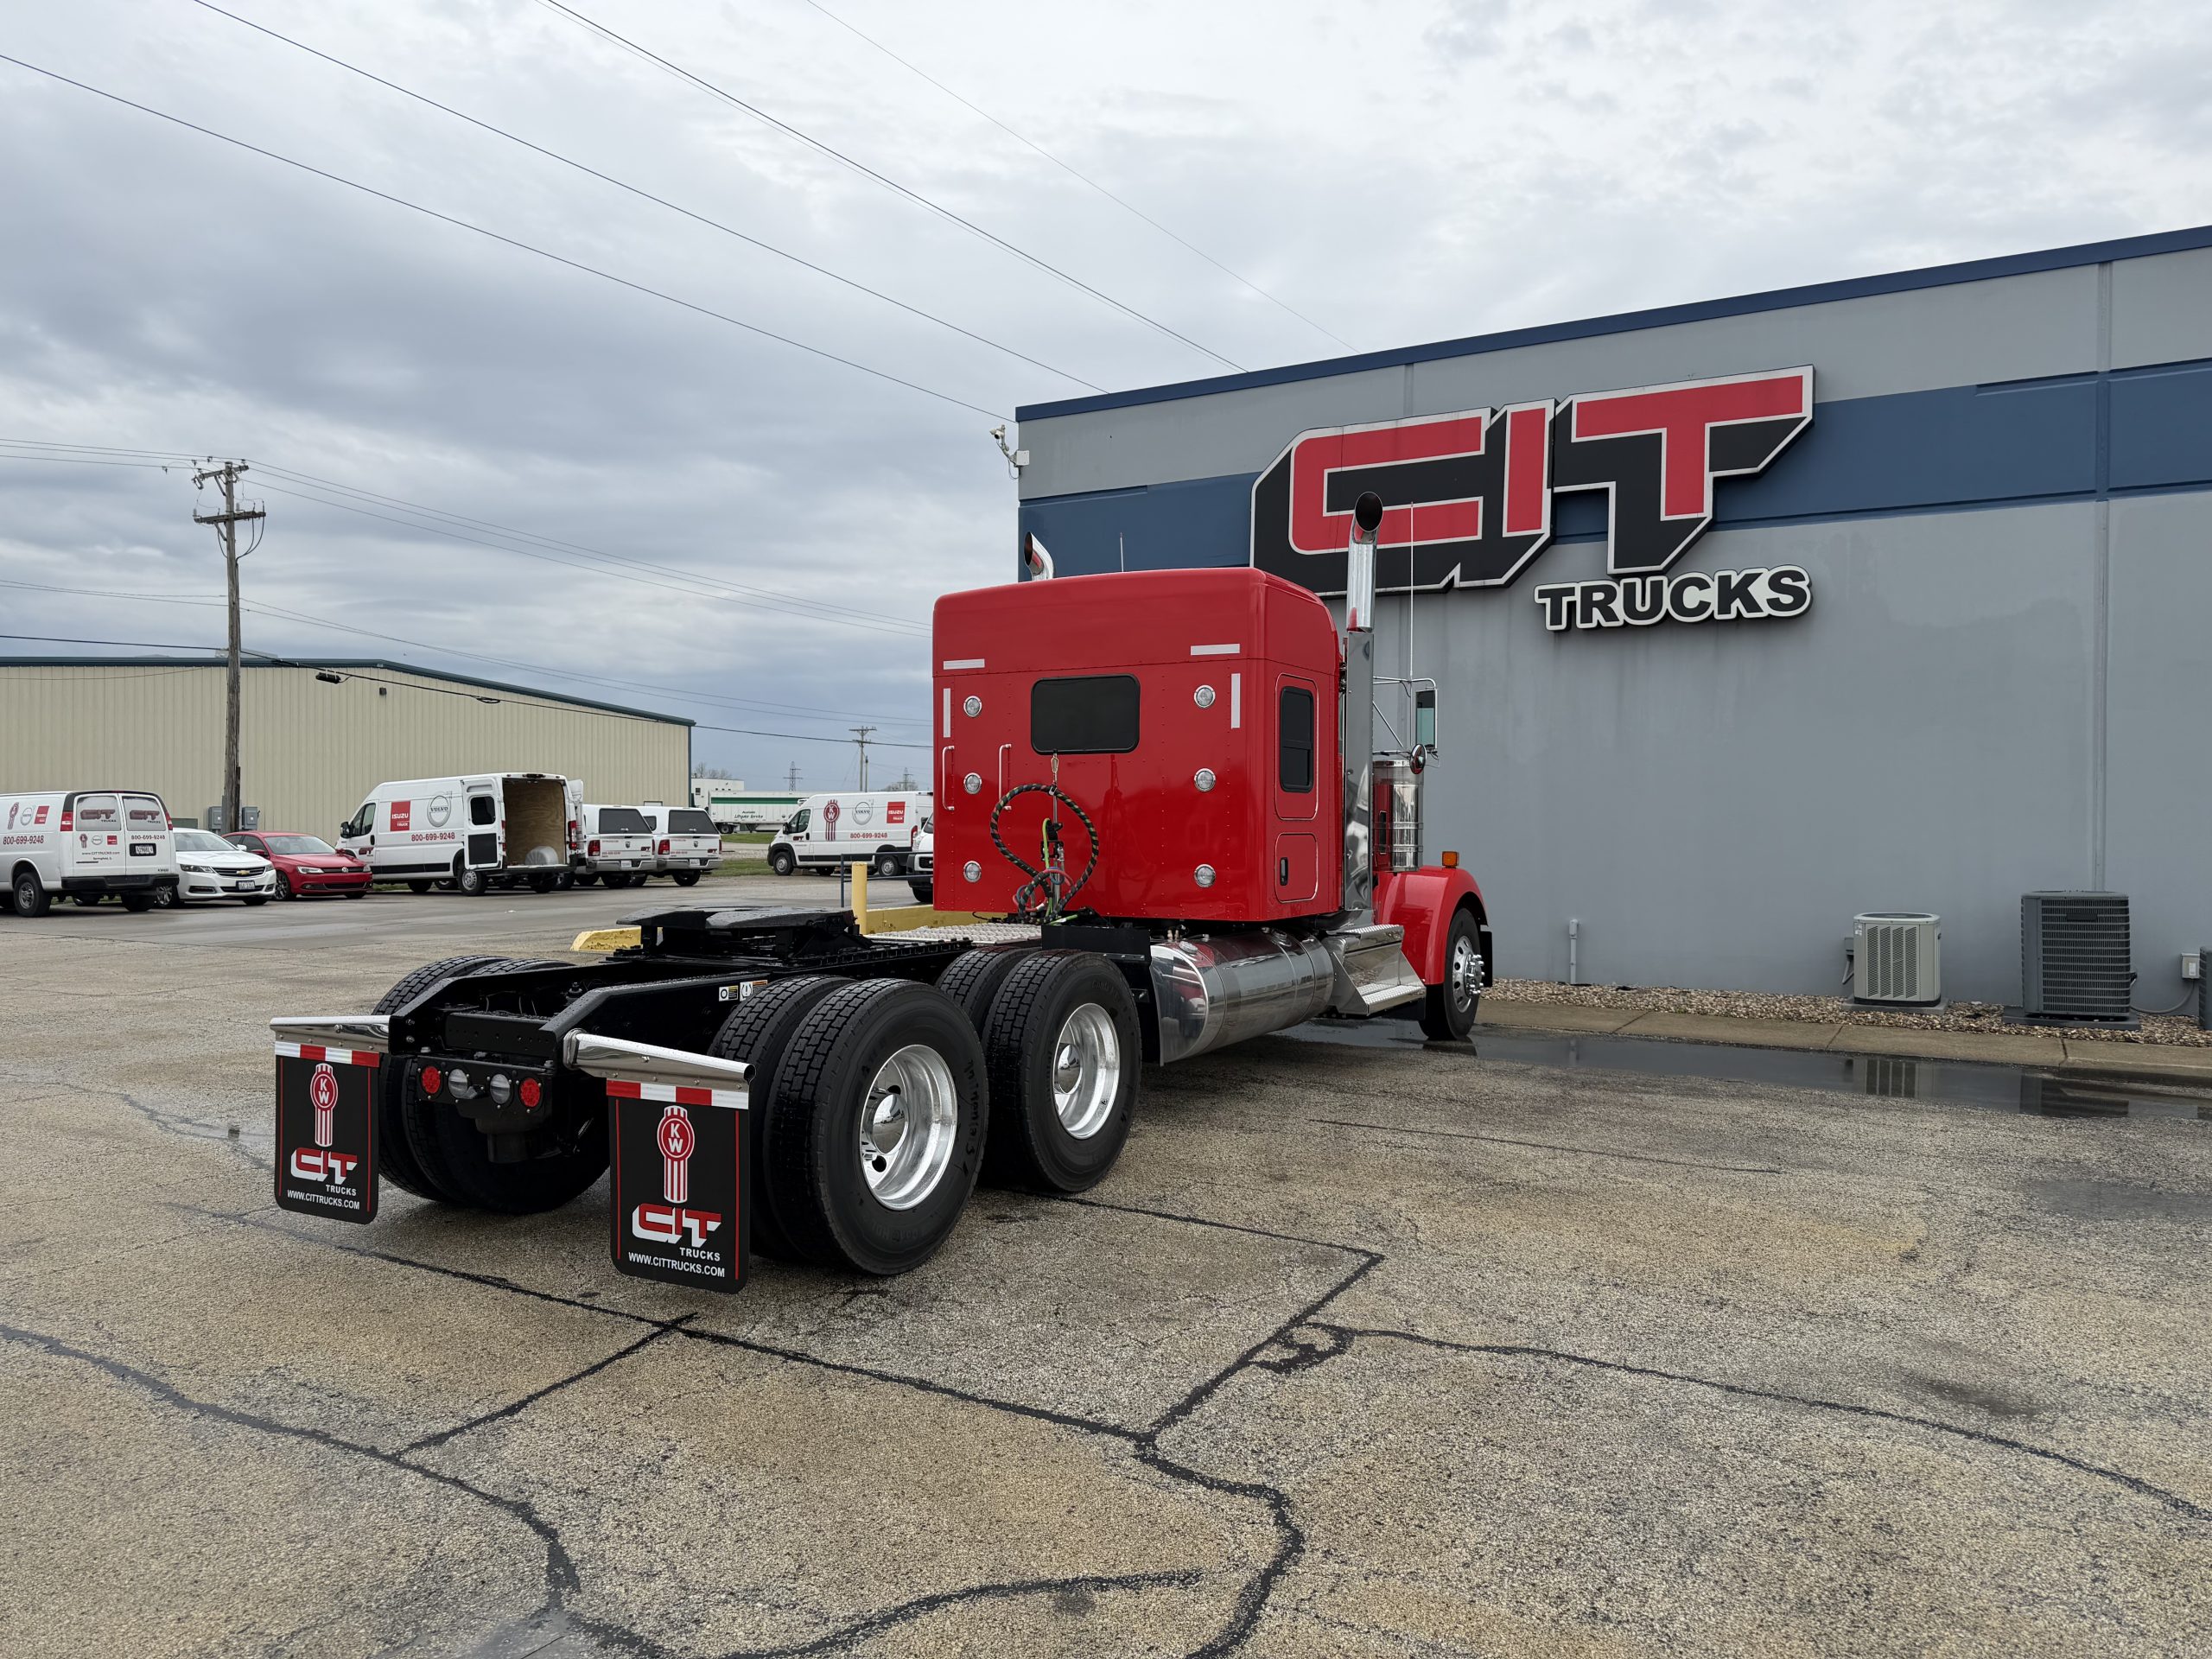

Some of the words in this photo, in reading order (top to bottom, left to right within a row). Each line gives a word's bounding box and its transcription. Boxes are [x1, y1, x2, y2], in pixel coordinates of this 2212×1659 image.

[1251, 366, 1813, 594] CIT
[1535, 565, 1813, 632] TRUCKS
[3, 835, 45, 845] 800-699-9248
[410, 832, 455, 842] 800-699-9248
[320, 1077, 328, 1091] K
[318, 1090, 330, 1104] W
[670, 1122, 681, 1138] K
[667, 1137, 683, 1154] W
[290, 1147, 358, 1185] CIT
[325, 1184, 358, 1197] TRUCKS
[287, 1189, 360, 1211] WWW.CITTRUCKS.COM
[632, 1202, 721, 1248] CIT
[679, 1247, 721, 1262] TRUCKS
[628, 1251, 726, 1279] WWW.CITTRUCKS.COM
